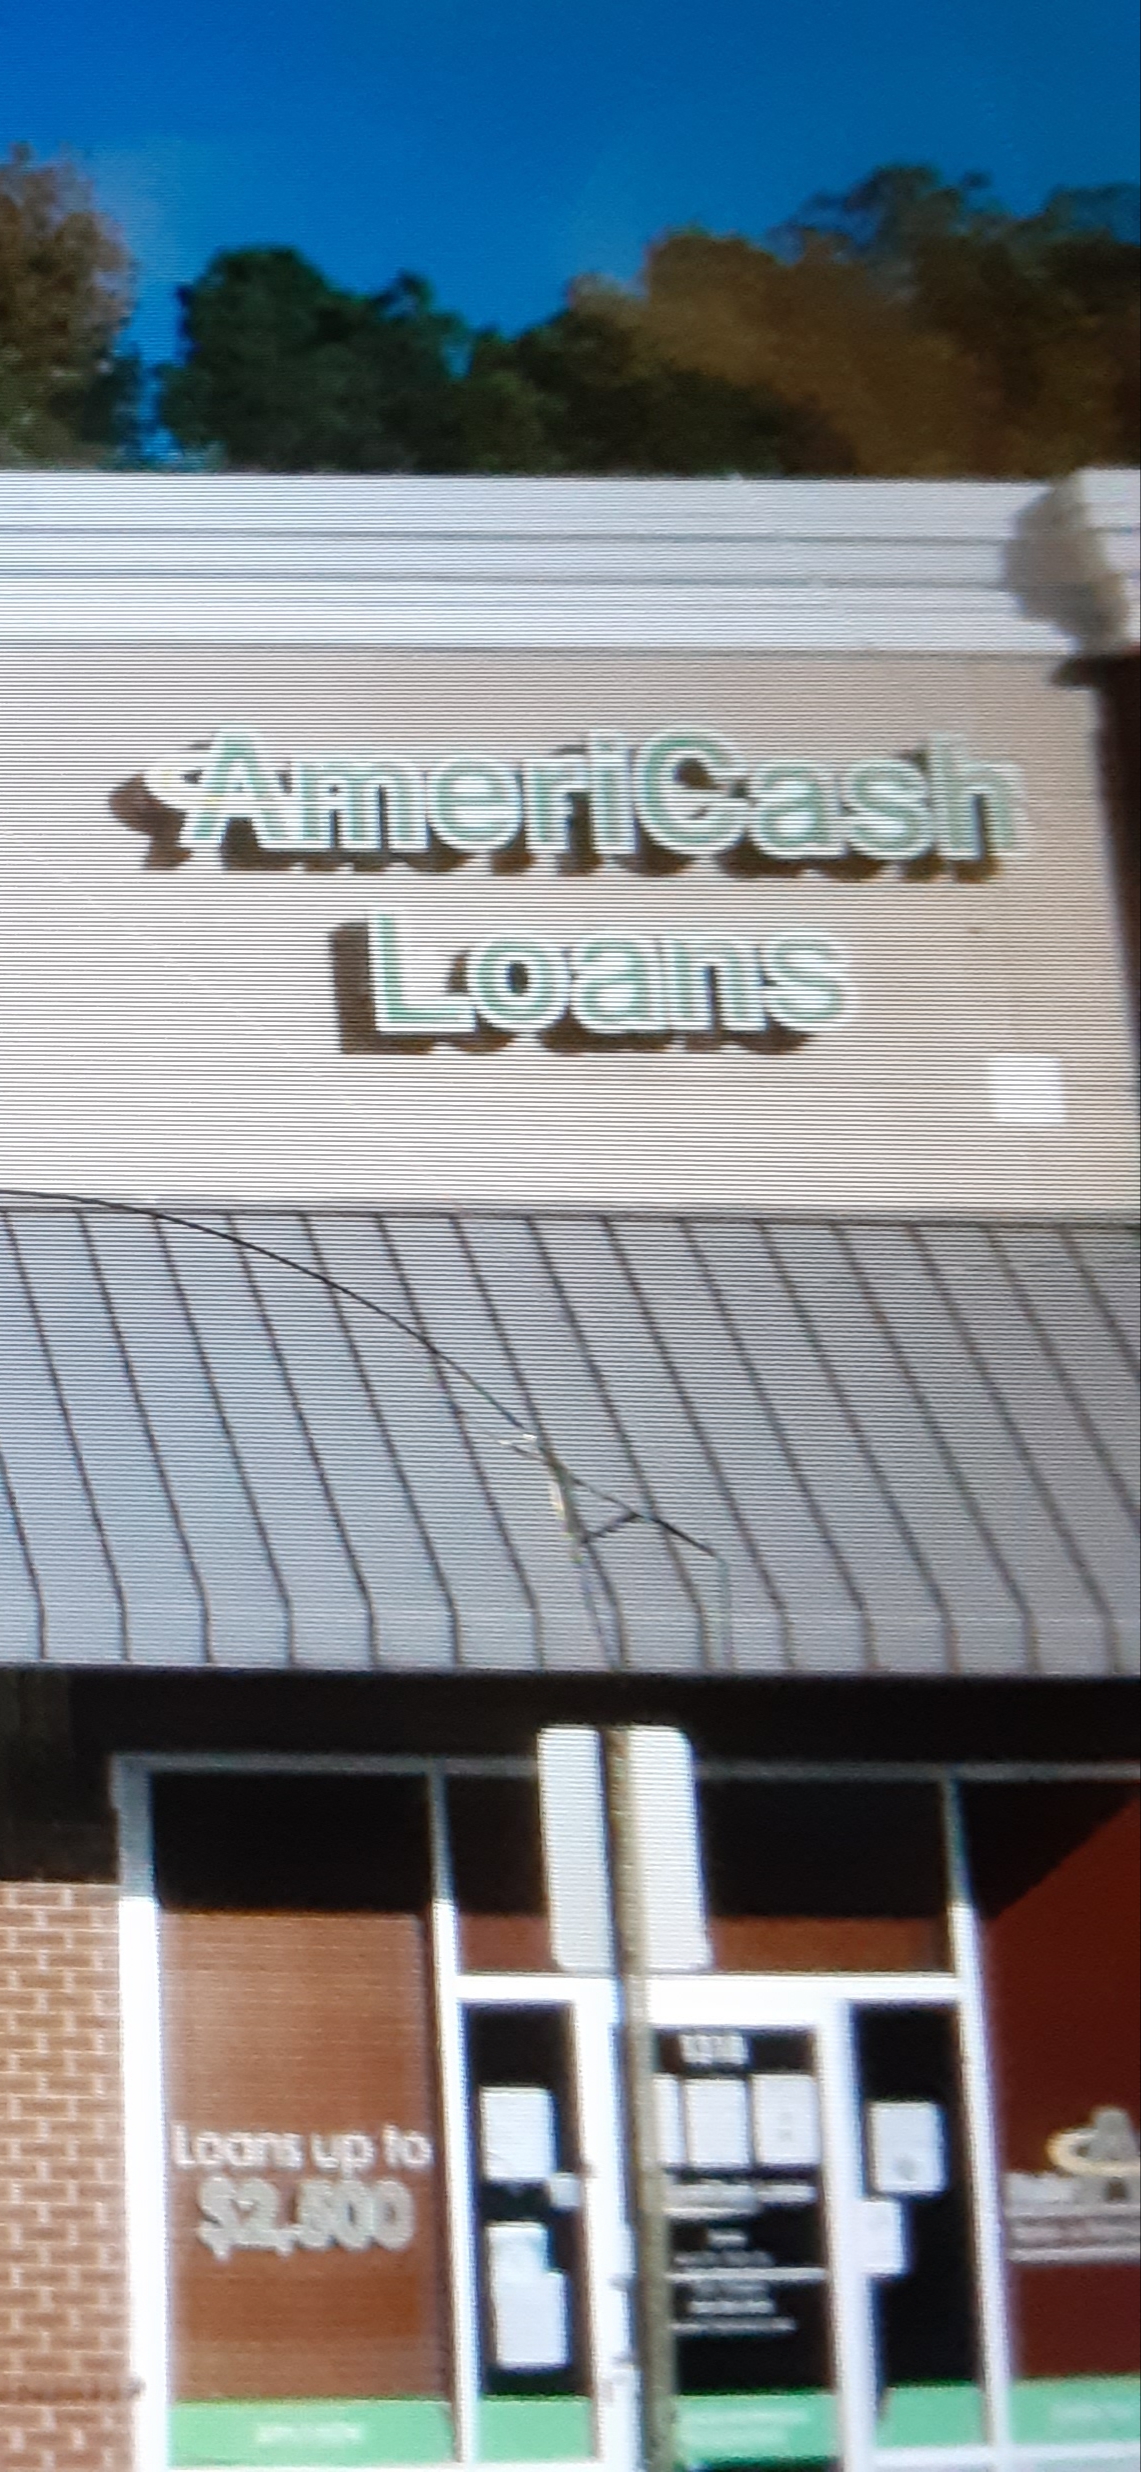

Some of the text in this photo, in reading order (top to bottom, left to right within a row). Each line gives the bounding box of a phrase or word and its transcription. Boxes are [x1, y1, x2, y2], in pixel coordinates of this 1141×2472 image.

[158, 728, 1028, 860] AmeriCash
[364, 914, 854, 1038] Loans
[170, 2120, 434, 2180] Loans up to
